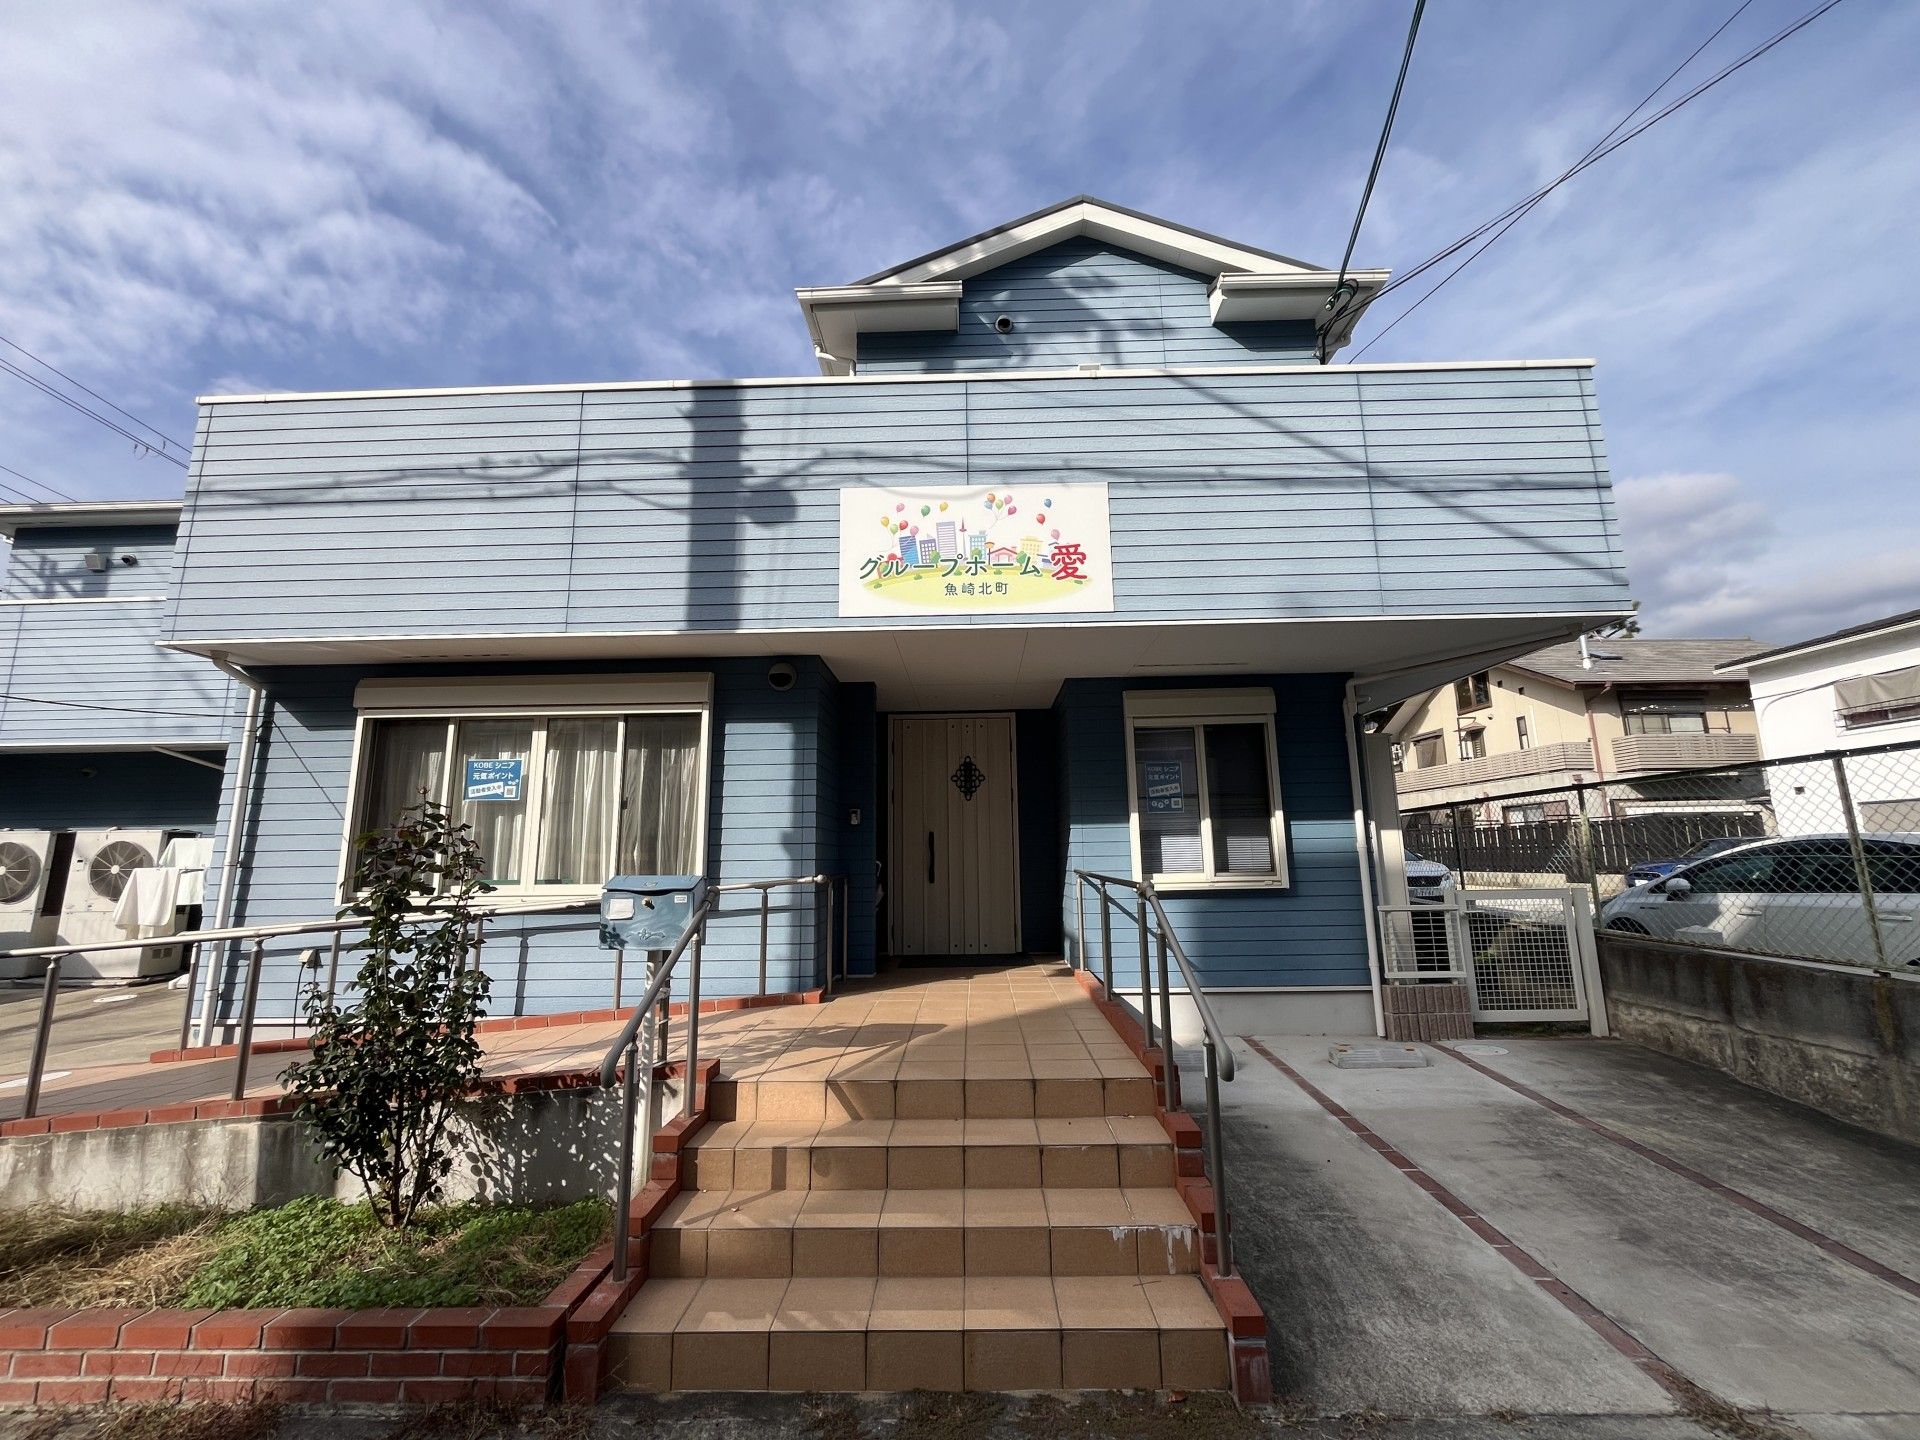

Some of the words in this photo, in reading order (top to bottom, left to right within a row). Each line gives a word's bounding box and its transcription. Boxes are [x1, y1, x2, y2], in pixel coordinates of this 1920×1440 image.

[944, 581, 1009, 597] 魚崎北町
[473, 761, 494, 769] KOBE
[495, 761, 515, 769] シニア
